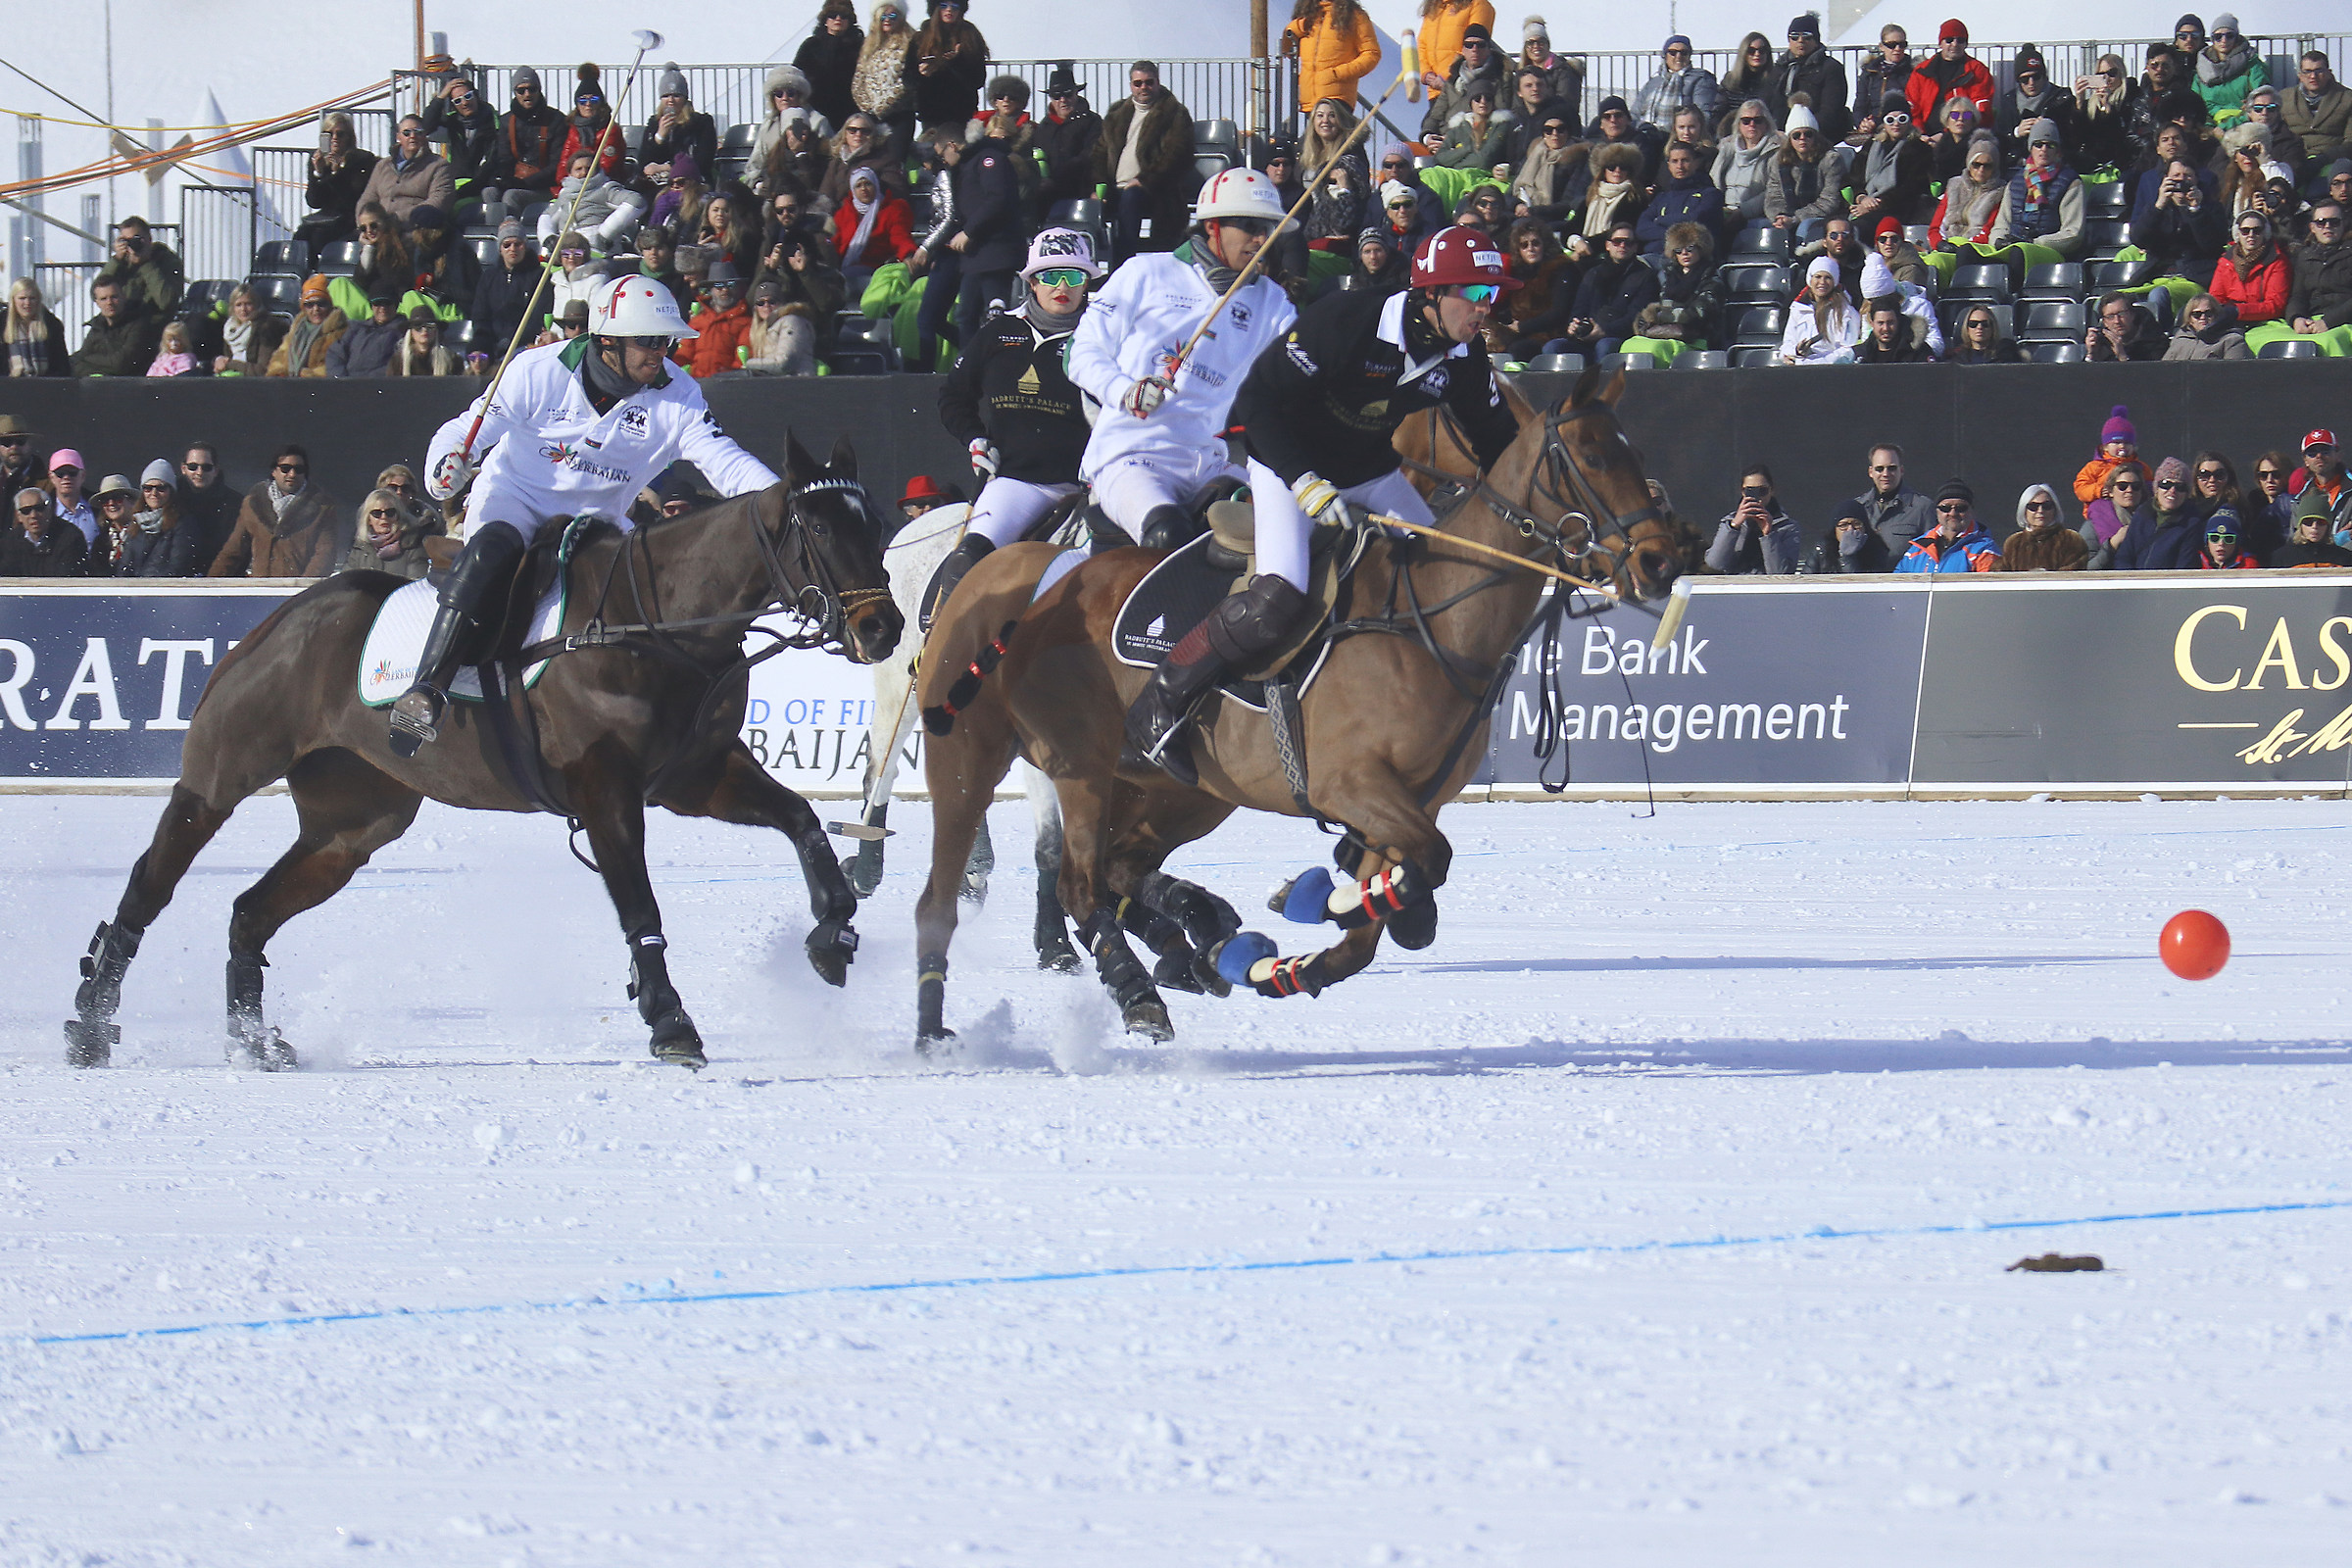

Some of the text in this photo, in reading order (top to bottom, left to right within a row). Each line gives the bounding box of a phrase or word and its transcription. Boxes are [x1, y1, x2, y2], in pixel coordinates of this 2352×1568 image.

[1581, 625, 1710, 675] Bank
[0, 637, 241, 732] RAT
[785, 699, 825, 725] OF
[839, 700, 875, 725] FI
[1509, 690, 1850, 753] Management
[748, 728, 923, 781] BAIJAN
